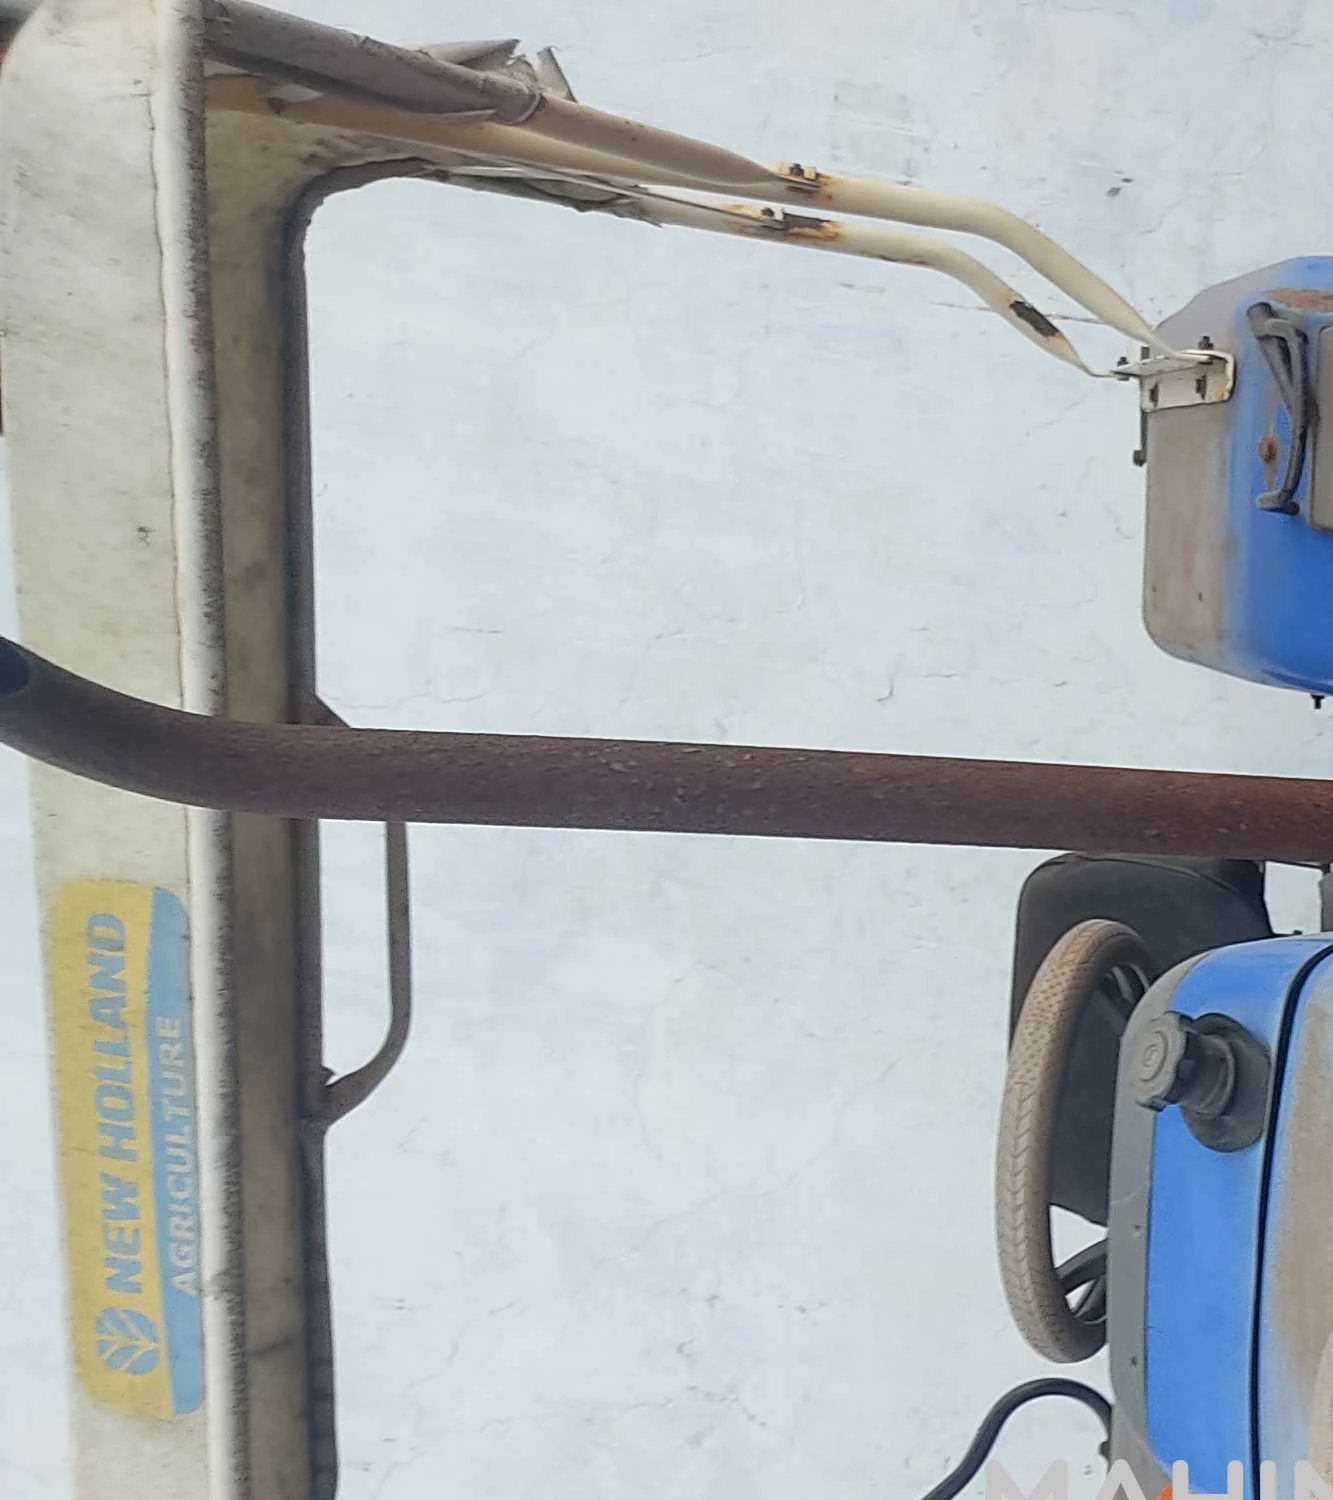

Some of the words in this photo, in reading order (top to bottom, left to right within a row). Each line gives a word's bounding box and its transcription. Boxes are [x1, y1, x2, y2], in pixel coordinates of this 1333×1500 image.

[87, 912, 138, 1162] HOLLAND
[153, 1014, 198, 1296] AGRICULTURE
[100, 1172, 143, 1294] NEW
